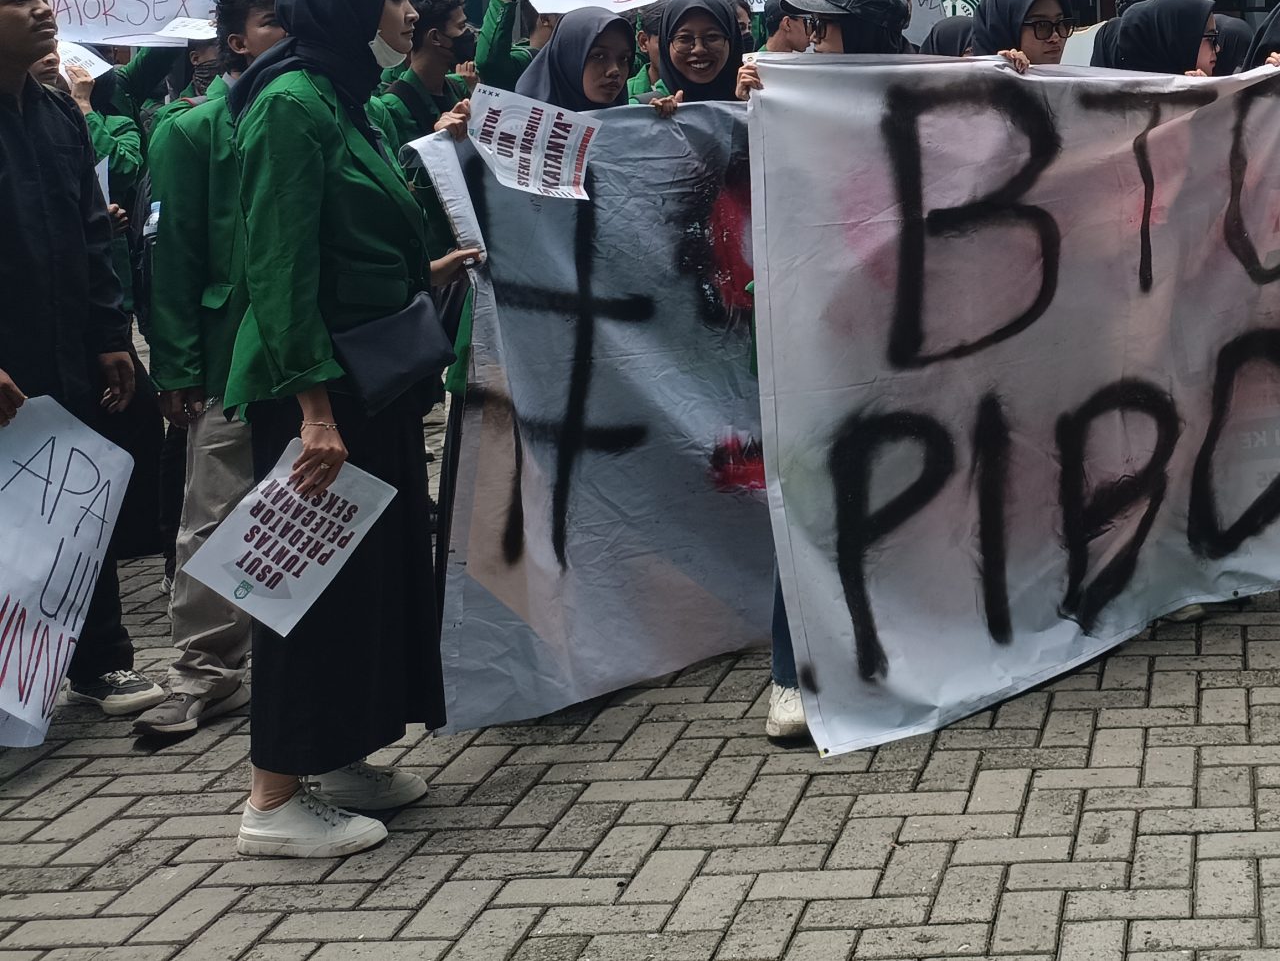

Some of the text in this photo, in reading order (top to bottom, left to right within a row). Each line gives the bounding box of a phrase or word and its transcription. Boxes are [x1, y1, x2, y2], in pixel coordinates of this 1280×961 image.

[478, 107, 502, 145] UNTUK
[497, 131, 517, 159] UIN
[517, 156, 532, 188] SYEKH
[1, 436, 110, 550] APA
[260, 478, 355, 549] PELECAHAN
[243, 524, 309, 579] TUNTAS
[249, 499, 336, 566] PREDATOR
[235, 550, 284, 590] USUT
